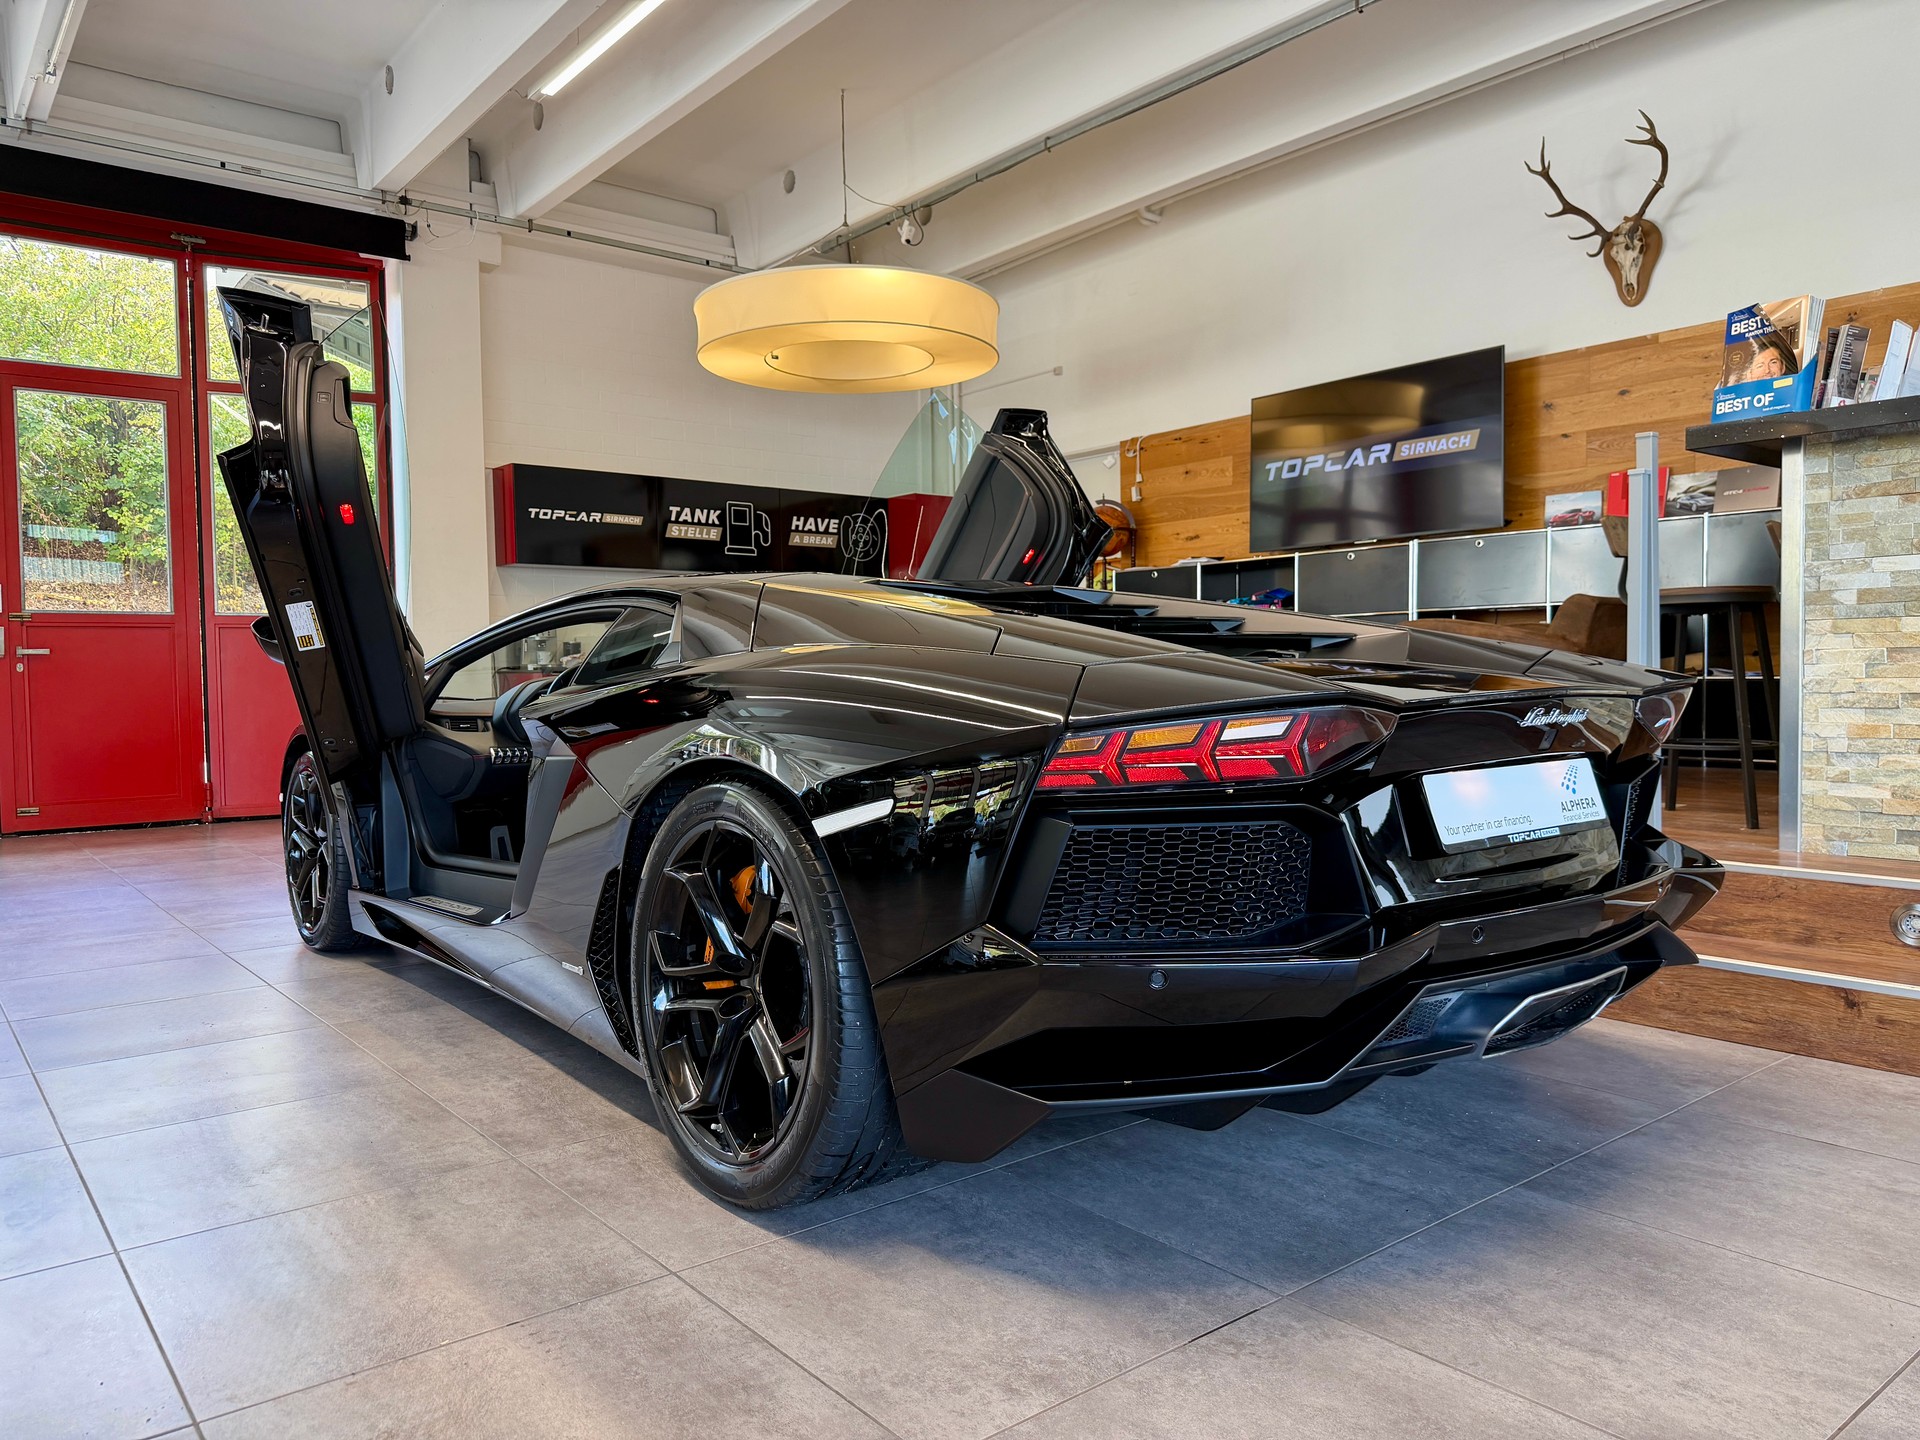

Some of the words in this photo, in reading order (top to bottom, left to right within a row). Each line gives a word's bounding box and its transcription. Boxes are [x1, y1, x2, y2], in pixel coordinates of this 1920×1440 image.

[1731, 316, 1762, 335] BEST
[1716, 397, 1751, 415] BEST
[1753, 392, 1775, 408] OF
[1265, 443, 1392, 481] TOPCAR
[1400, 434, 1471, 457] SIRNACH
[528, 507, 602, 523] TOPCAR
[606, 515, 640, 524] SIRNACH
[669, 506, 721, 525] TANK
[671, 526, 718, 539] STELLE
[791, 516, 839, 533] HAVE
[793, 535, 801, 543] A
[803, 535, 833, 545] BREAK
[1561, 797, 1597, 812] ALPHERA
[1444, 825, 1460, 836] Your
[1462, 821, 1485, 836] partner
[1485, 819, 1493, 829] in
[1494, 819, 1503, 829] car
[1508, 830, 1542, 843] TOPCAR
